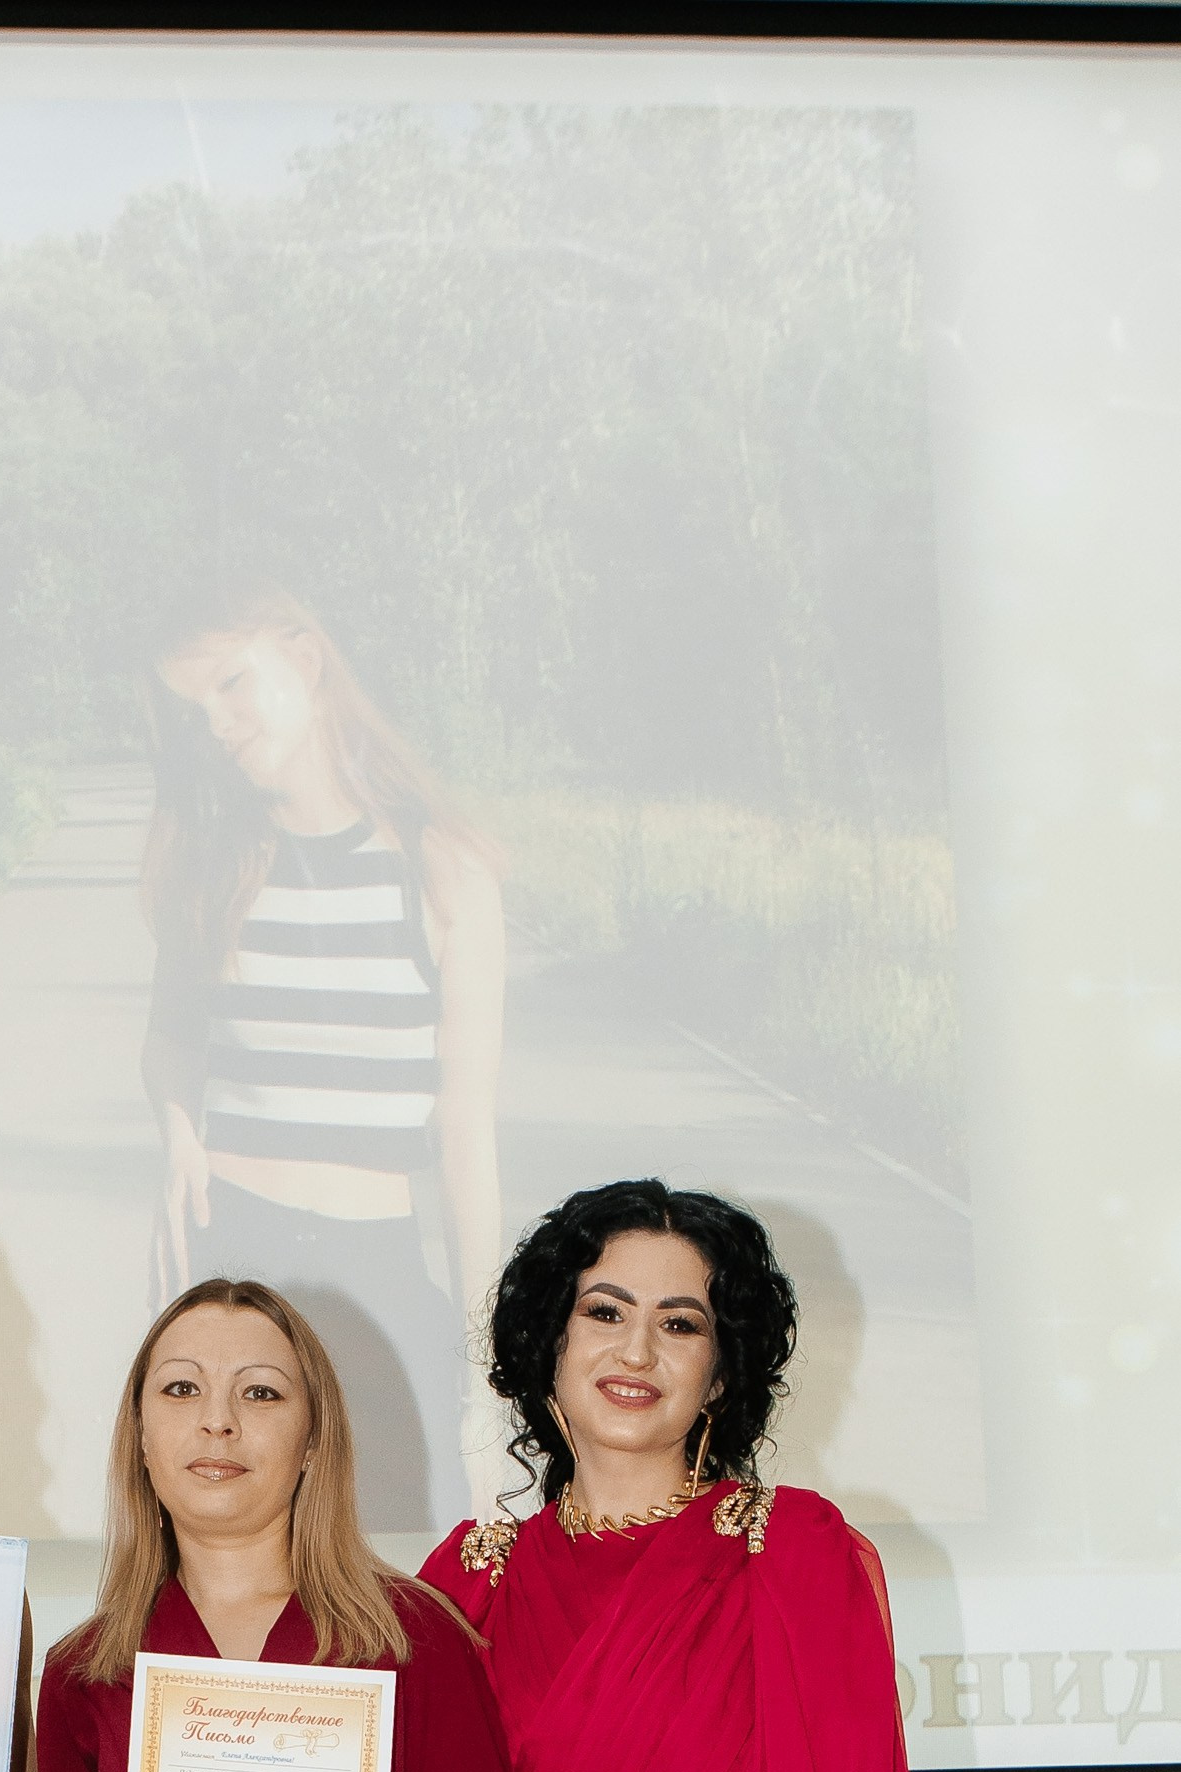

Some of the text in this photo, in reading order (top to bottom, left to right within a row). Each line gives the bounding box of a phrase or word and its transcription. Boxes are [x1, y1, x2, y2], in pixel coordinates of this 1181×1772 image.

[183, 1696, 344, 1729] Благодарственное
[182, 1720, 255, 1745] Письмо
[220, 1751, 242, 1759] Елена
